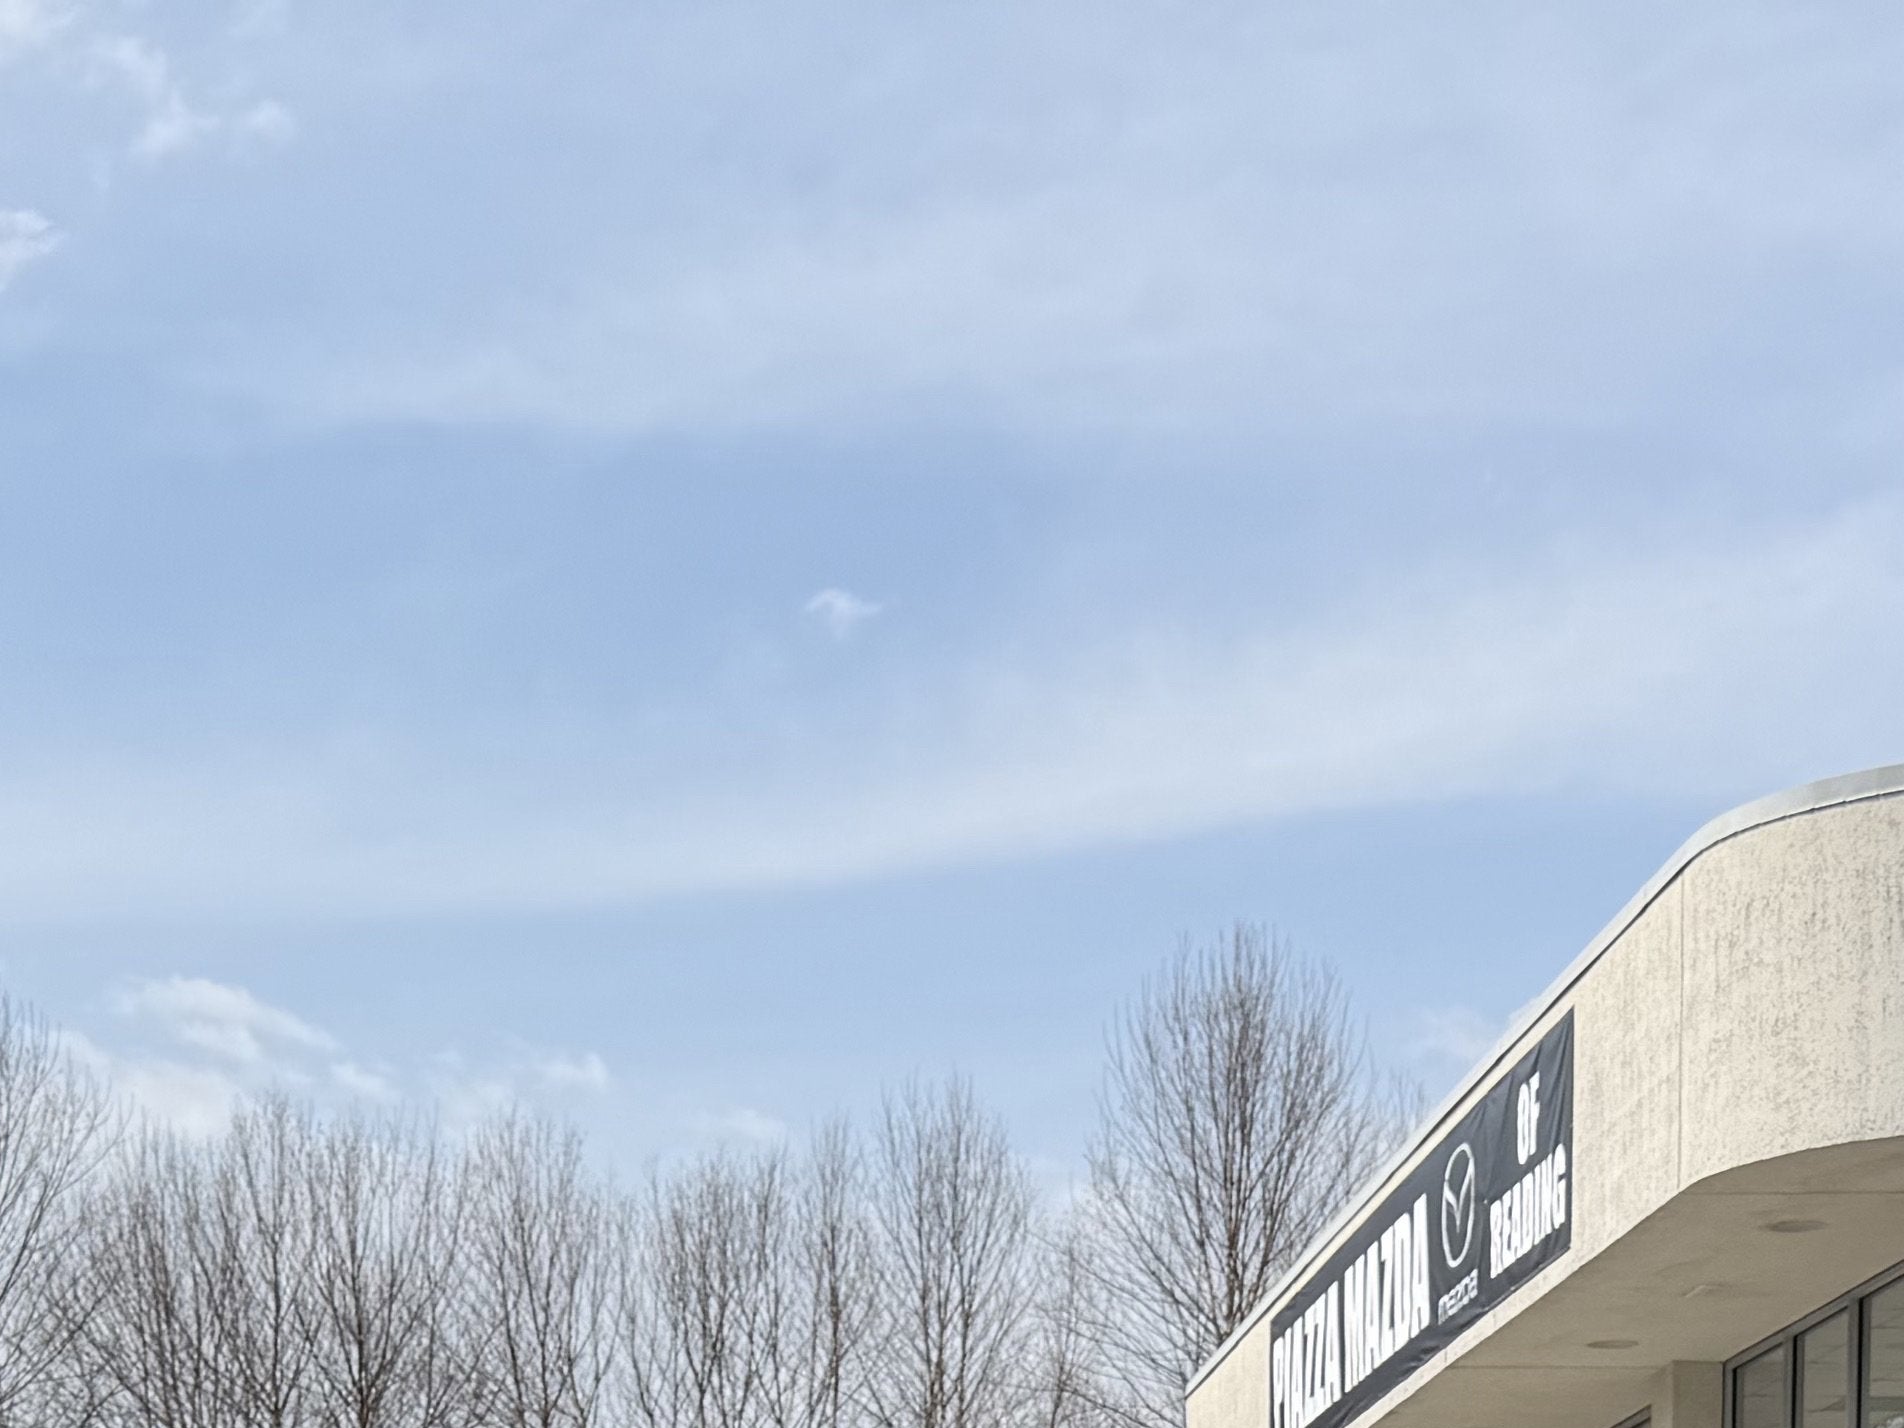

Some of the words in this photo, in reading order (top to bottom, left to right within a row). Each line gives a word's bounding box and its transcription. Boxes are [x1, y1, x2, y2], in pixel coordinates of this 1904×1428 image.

[1517, 1071, 1541, 1165] OF
[1489, 1143, 1567, 1279] READING
[1344, 1193, 1430, 1393] MAZDA
